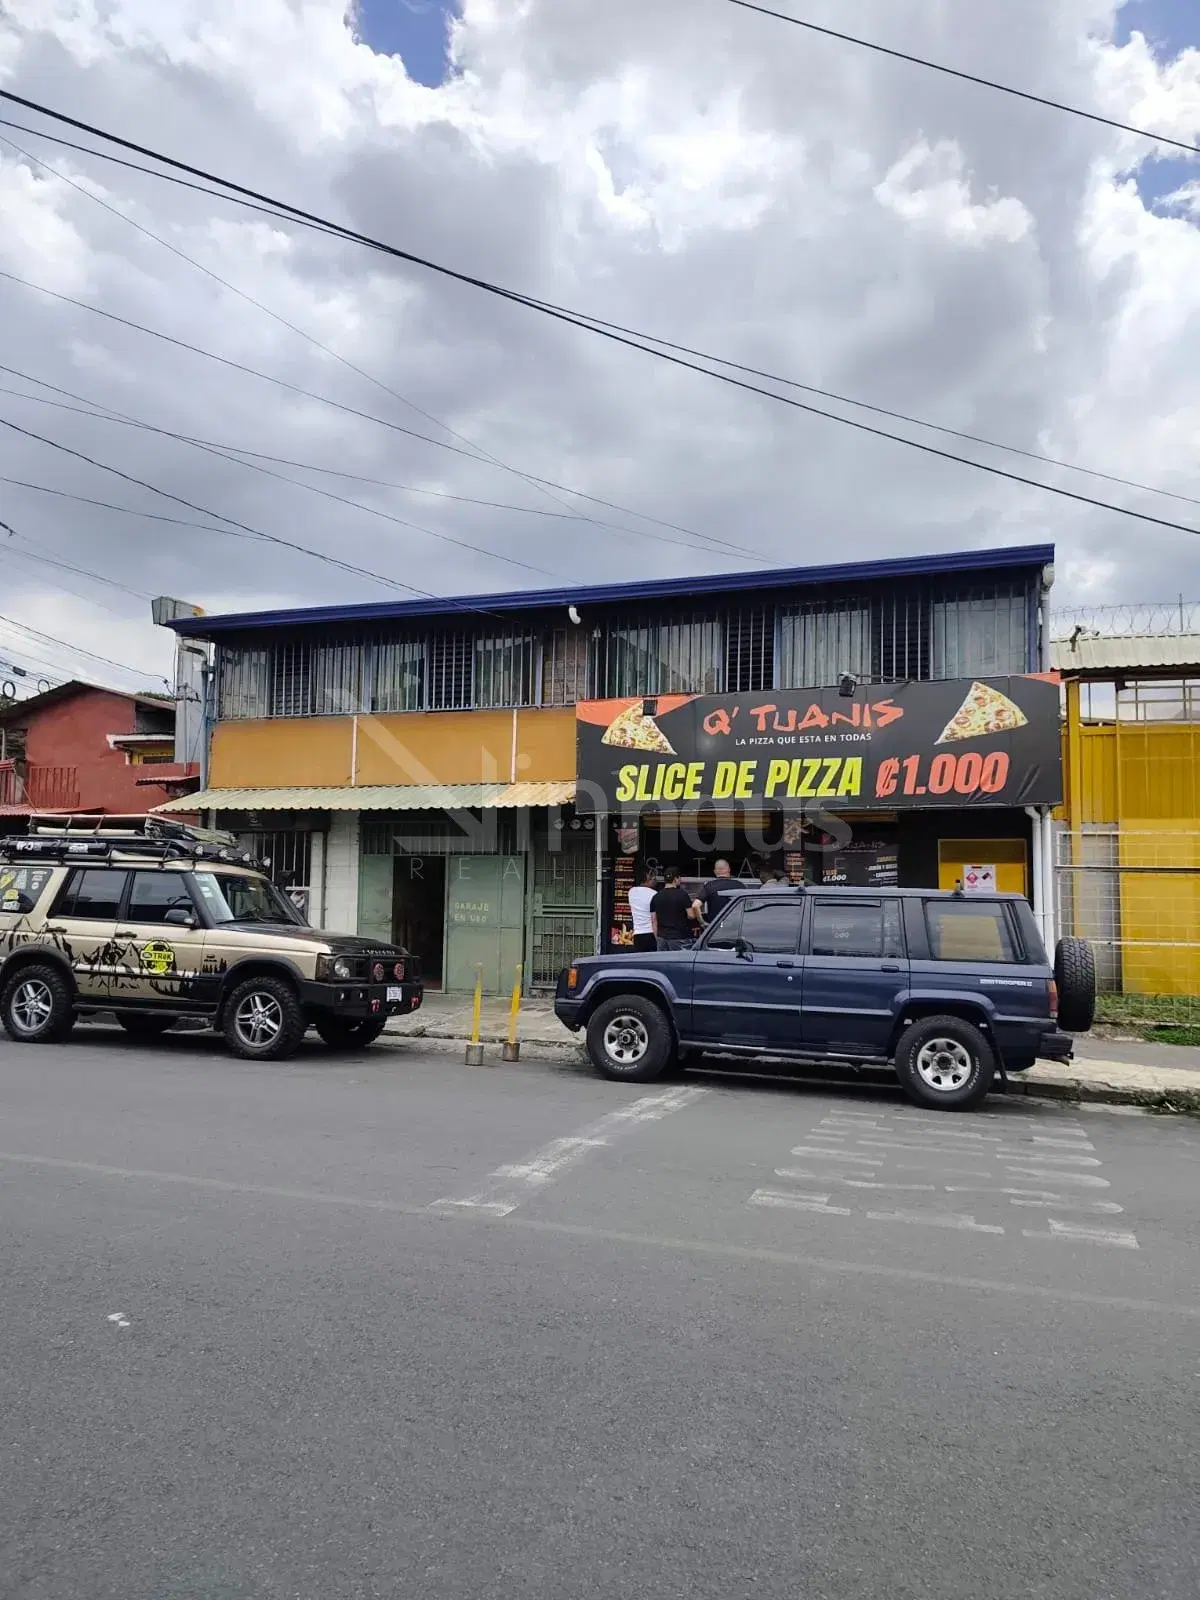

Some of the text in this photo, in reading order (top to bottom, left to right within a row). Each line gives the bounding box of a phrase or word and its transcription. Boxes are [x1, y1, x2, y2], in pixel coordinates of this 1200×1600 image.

[749, 698, 904, 732] TUANIS
[735, 733, 872, 746] LA PIZZA QUE ESTA EN TODAS
[615, 761, 705, 802] SLICE
[711, 759, 758, 800] DE
[764, 756, 863, 798] PIZZA
